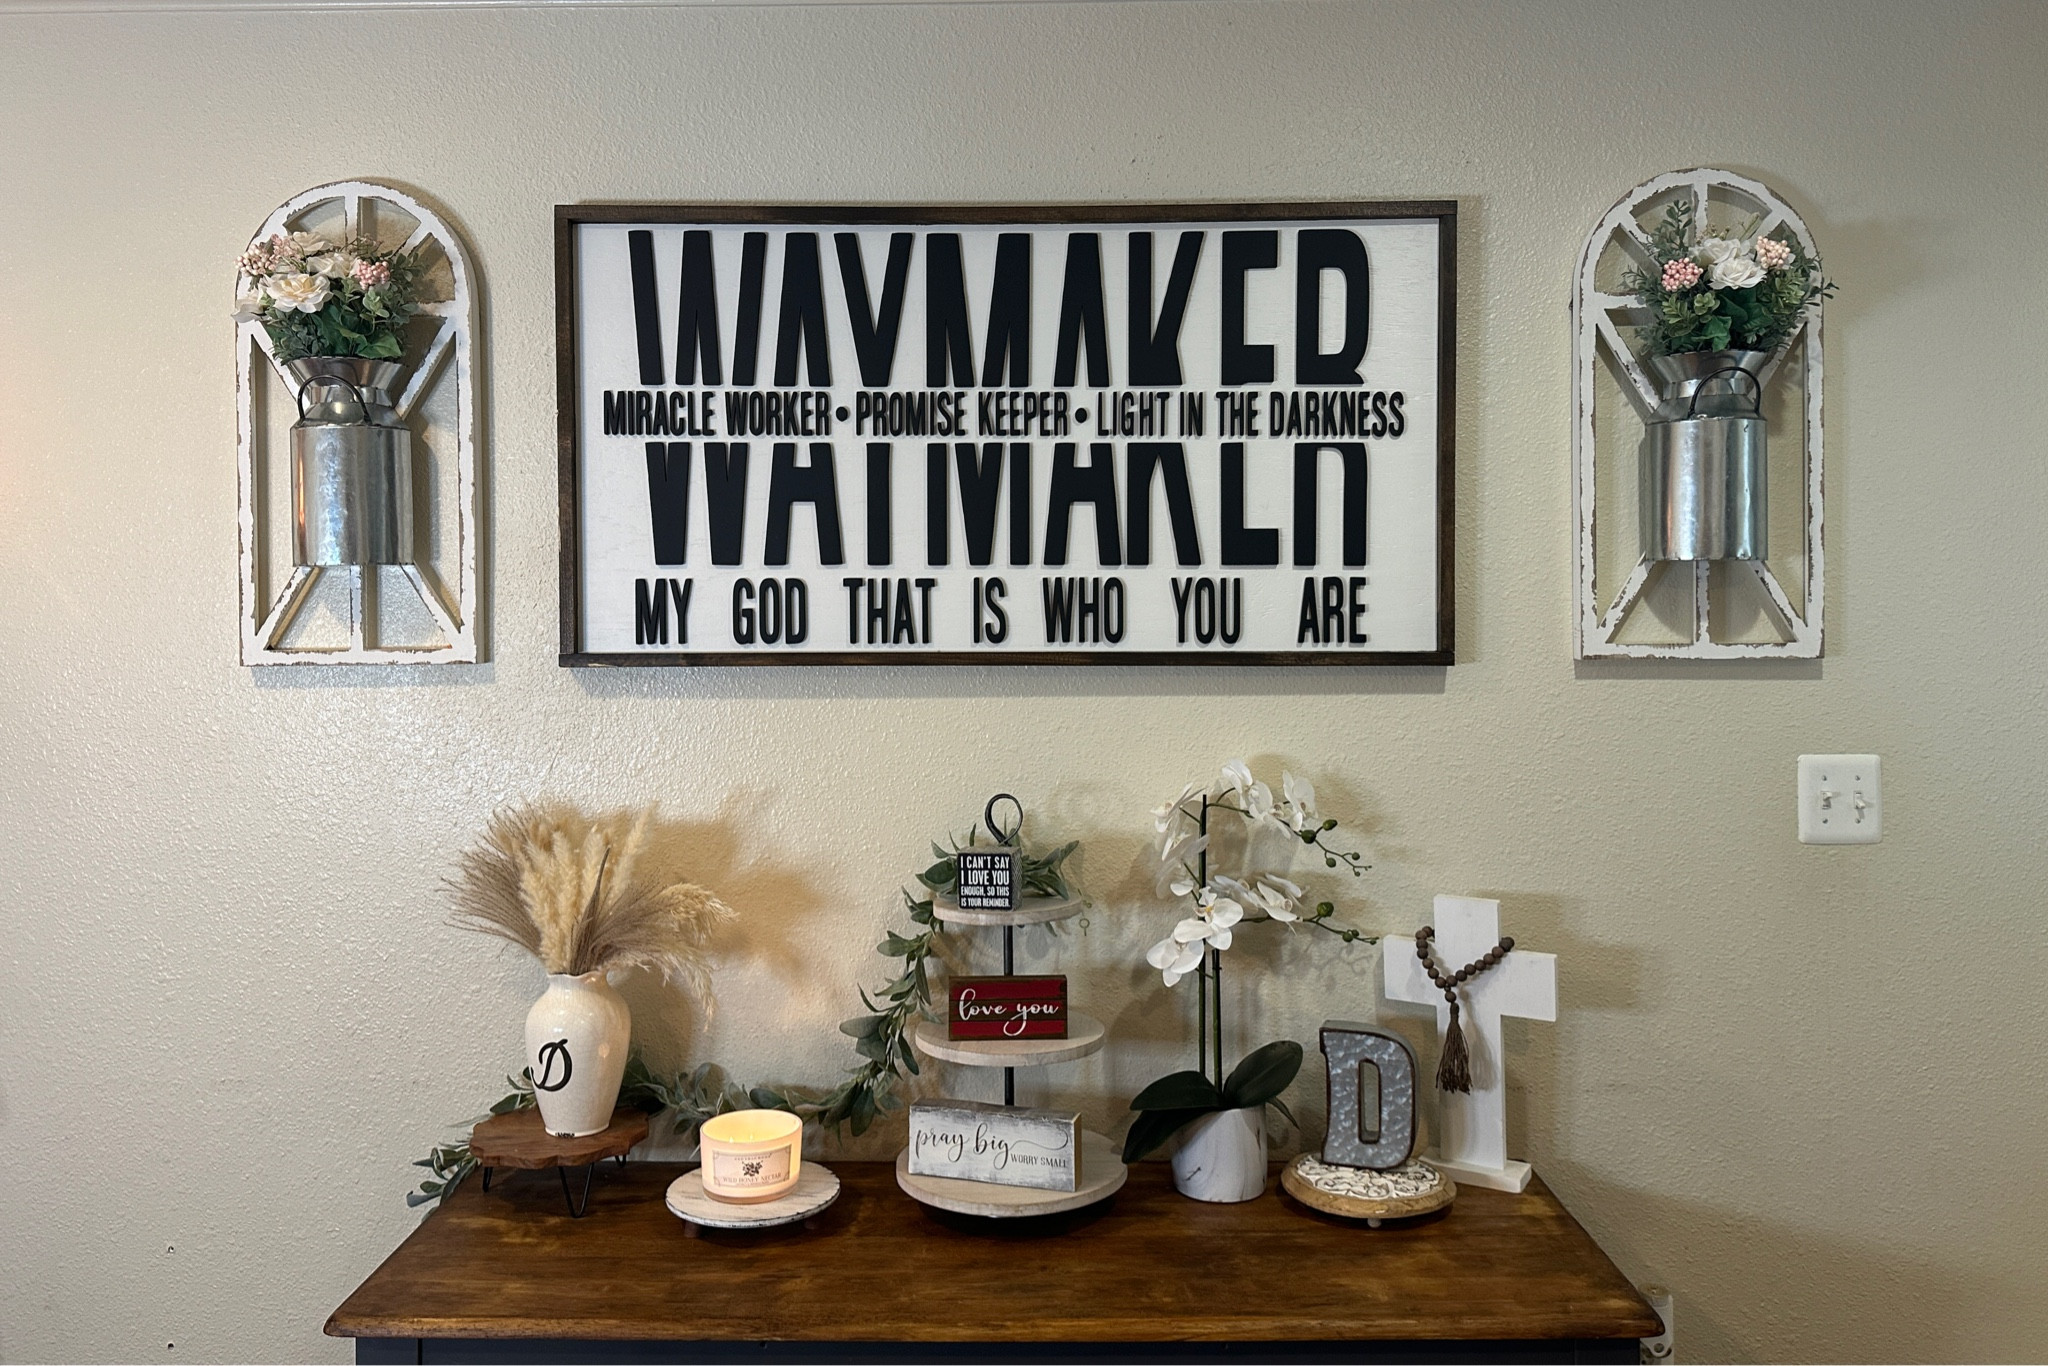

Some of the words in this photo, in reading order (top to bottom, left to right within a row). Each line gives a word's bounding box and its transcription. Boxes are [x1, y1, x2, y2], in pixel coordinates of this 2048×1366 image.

[603, 390, 716, 437] MIRACLE
[725, 390, 831, 437] WORKER
[855, 390, 966, 437] PROMISE
[978, 390, 1069, 438] KEEPER
[1097, 390, 1171, 438] LIGHT
[1179, 391, 1205, 437] IN
[1216, 391, 1260, 437] THE
[1270, 390, 1405, 437] DARKNESS
[635, 578, 693, 645] MY
[733, 577, 809, 645] GOD
[843, 578, 936, 645] THAT
[973, 577, 1008, 644] IS
[1042, 577, 1125, 644] WHO
[1171, 577, 1241, 644] YOU
[1297, 577, 1367, 644] ARE
[966, 856, 991, 869] CAN'T
[994, 856, 1010, 869] SAY
[968, 870, 990, 885] LOVE
[992, 870, 1010, 885] YOU
[961, 886, 986, 896] ENOUGH,
[987, 886, 996, 896] SO
[996, 886, 1010, 896] THIS
[961, 897, 967, 907] IS
[968, 898, 982, 907] YOUR
[959, 988, 1007, 1021] love
[1003, 1002, 1059, 1037] you
[915, 1128, 970, 1163] pray
[1010, 1153, 1038, 1165] WORRY
[1041, 1157, 1068, 1169] SMALL
